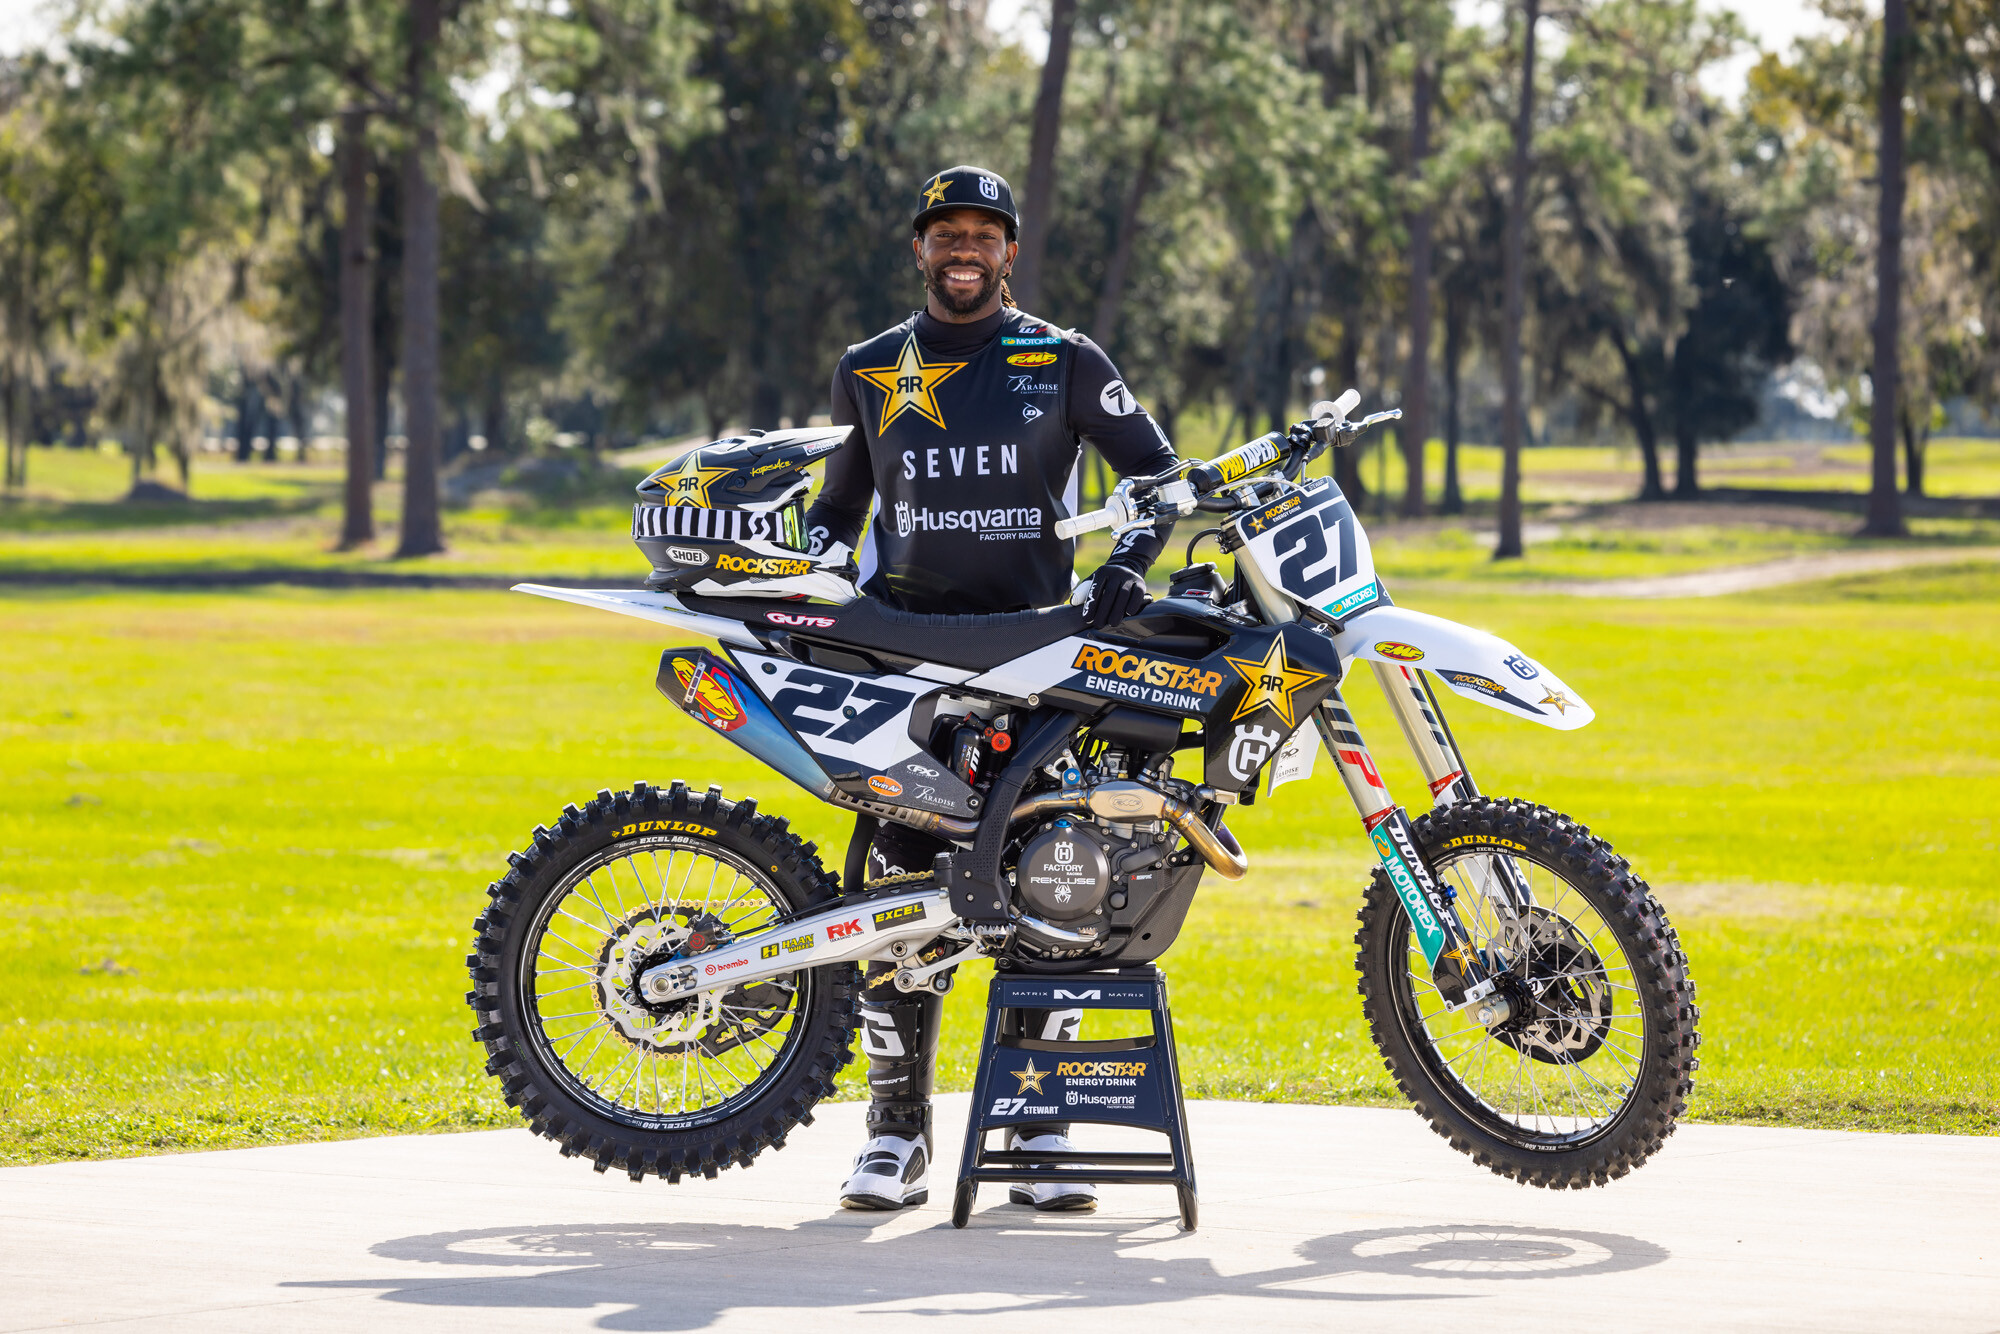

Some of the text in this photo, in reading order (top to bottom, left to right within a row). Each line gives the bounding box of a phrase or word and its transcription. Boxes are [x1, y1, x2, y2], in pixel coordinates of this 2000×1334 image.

[1016, 337, 1059, 345] MOTOREX
[1007, 352, 1058, 364] FMF
[1105, 383, 1126, 414] 7
[902, 444, 1018, 480] SEVEN
[1264, 496, 1302, 520] ROCKSTAR
[1272, 505, 1302, 523] ENERGY DRINK
[911, 506, 1042, 533] Husqvarna
[979, 530, 1042, 541] FACTORY RACING
[672, 549, 703, 562] SHOEI
[1273, 502, 1358, 600] 27
[715, 554, 811, 575] ROCKSTAR
[1340, 586, 1376, 609] MOTOREX
[767, 612, 836, 627] GUTS
[1375, 642, 1425, 660] FMF
[1072, 645, 1222, 696] ROCKSTAR
[1452, 673, 1505, 694] ROCKSTAR
[1455, 681, 1496, 697] ENERGY DRINK
[1085, 676, 1202, 710] ENERGY DRINK
[771, 669, 917, 745] 27
[871, 779, 900, 793] Twin Air
[621, 820, 718, 837] DUNLOP
[640, 836, 670, 844] EXCEL
[671, 835, 689, 844] A60
[1450, 835, 1527, 851] DUNLOP
[1043, 864, 1084, 872] FACTORY
[1388, 822, 1457, 929] DUNLOP
[1030, 876, 1096, 885] REKLUSE
[1385, 856, 1442, 938] MOTOREX
[875, 904, 923, 923] EXCEL
[826, 918, 863, 940] RK
[782, 933, 814, 949] HAAN
[788, 942, 814, 953] WHEELS
[717, 959, 749, 972] brembo
[1056, 1061, 1147, 1077] ROCKSTAR
[871, 1075, 910, 1085] GAERNE
[1065, 1078, 1137, 1086] ENERGY DRINK
[990, 1098, 1059, 1115] 27 STEWART
[1079, 1094, 1135, 1106] Husqvarna
[663, 1121, 692, 1129] EXCEL
